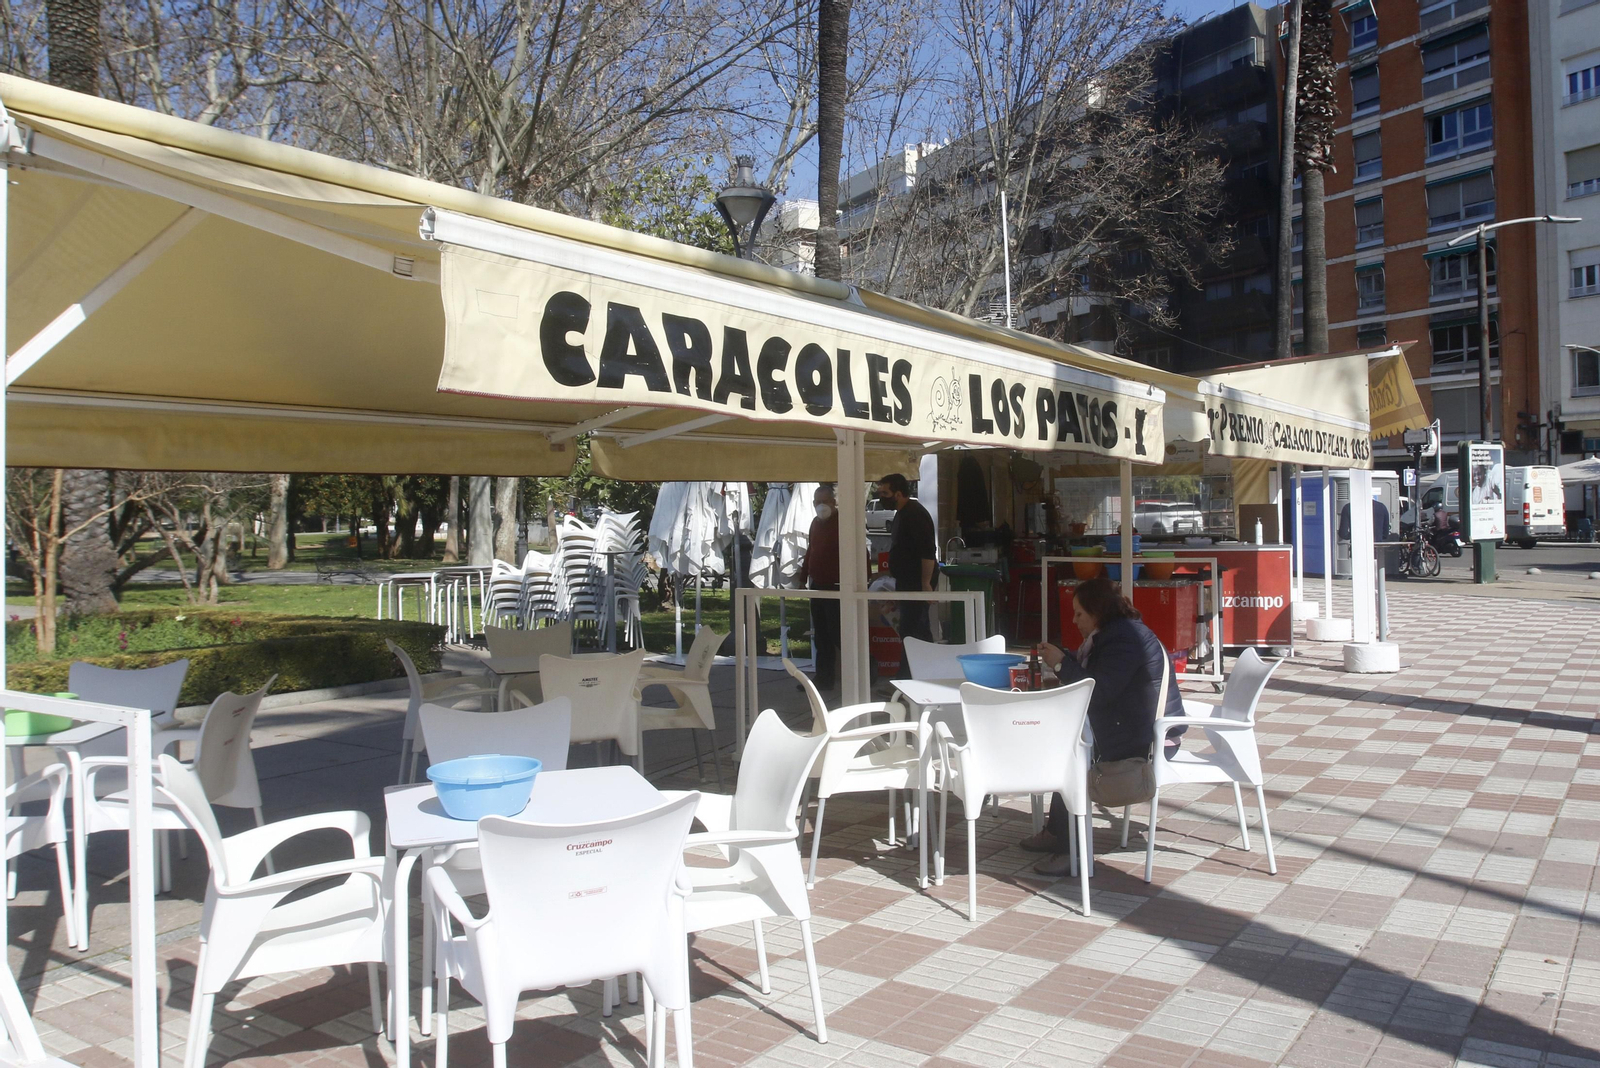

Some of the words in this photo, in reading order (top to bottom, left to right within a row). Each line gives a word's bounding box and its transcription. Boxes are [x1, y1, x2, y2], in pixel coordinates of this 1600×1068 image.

[539, 290, 913, 427] CARACOLES
[970, 373, 1027, 440] LOS
[1036, 386, 1119, 449] PATOS
[1219, 403, 1264, 445] PREMIO
[1272, 422, 1315, 453] CARACOL
[1328, 434, 1350, 459] PLATA
[566, 838, 613, 851] Cruzcampo
[575, 848, 603, 857] ESPECIAL
